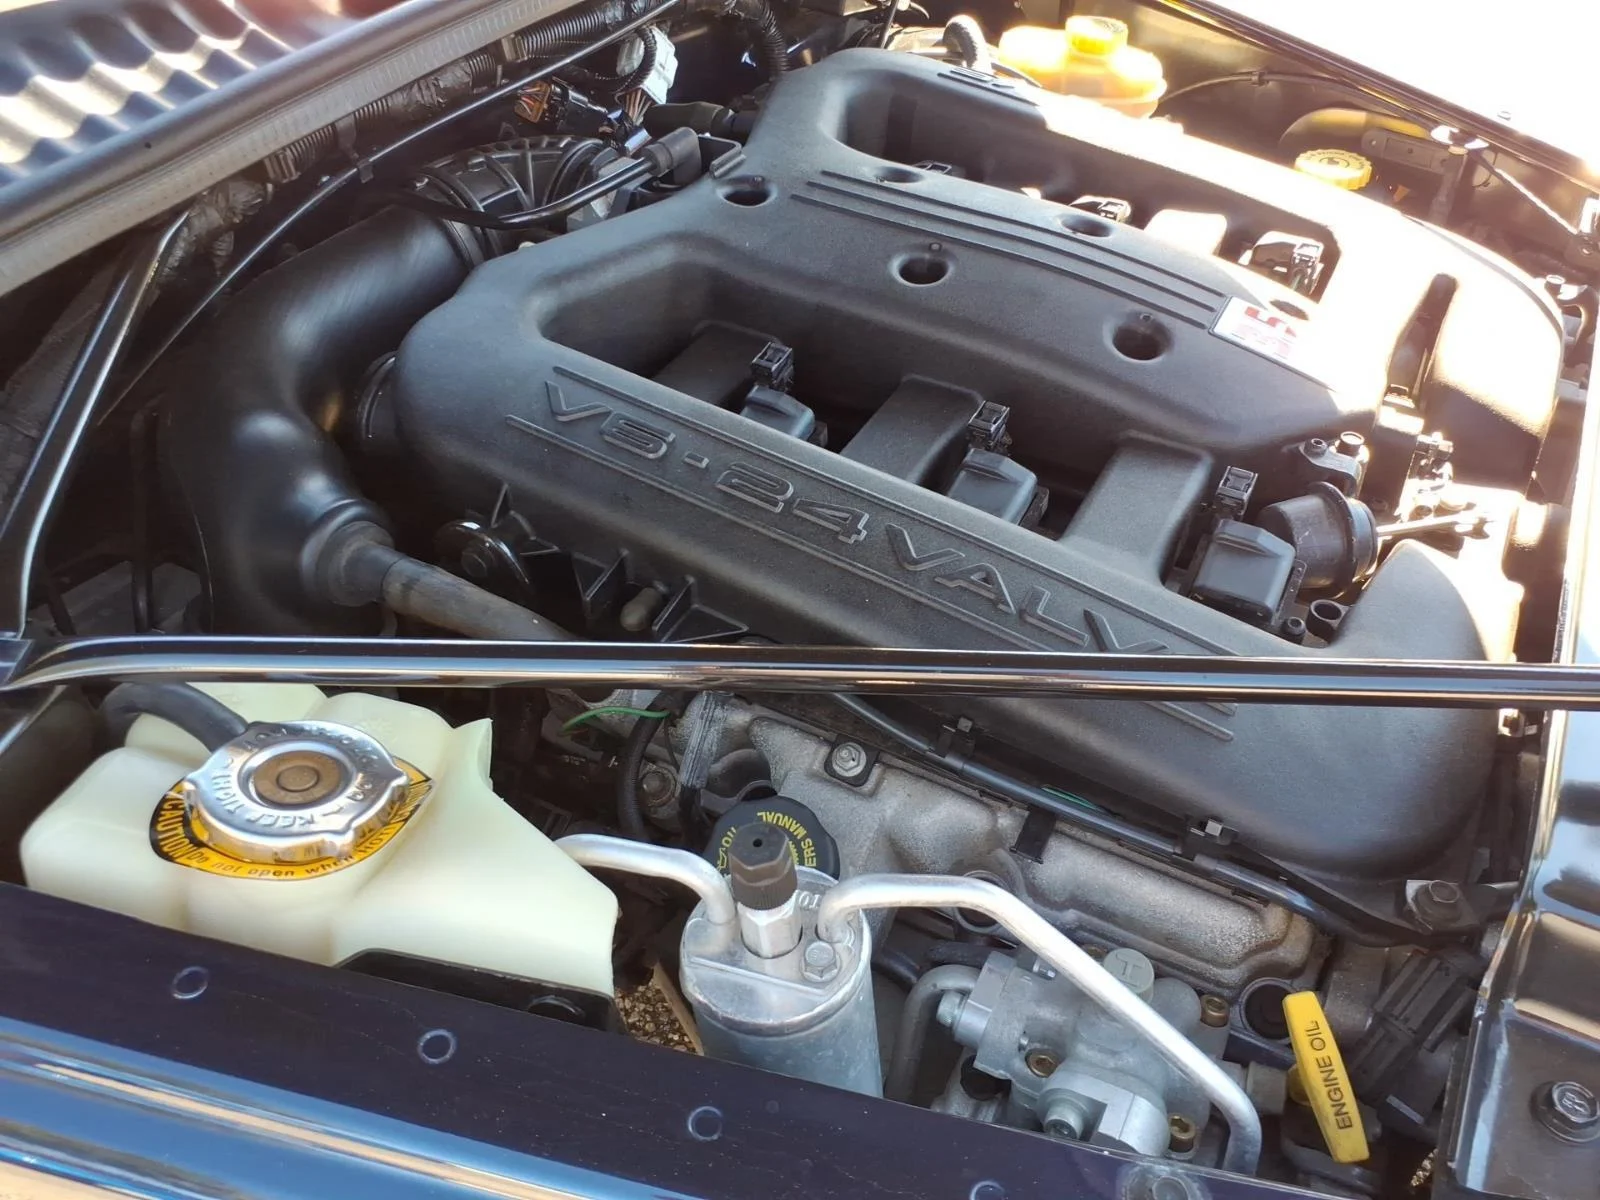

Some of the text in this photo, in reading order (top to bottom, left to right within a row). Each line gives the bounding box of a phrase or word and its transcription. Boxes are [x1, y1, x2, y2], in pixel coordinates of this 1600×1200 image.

[885, 522, 1170, 653] VALV
[156, 799, 198, 858] CAUTION
[247, 867, 295, 878] open
[757, 811, 817, 868] ERS MANUAL
[1305, 1020, 1353, 1130] ENGINE OIL
